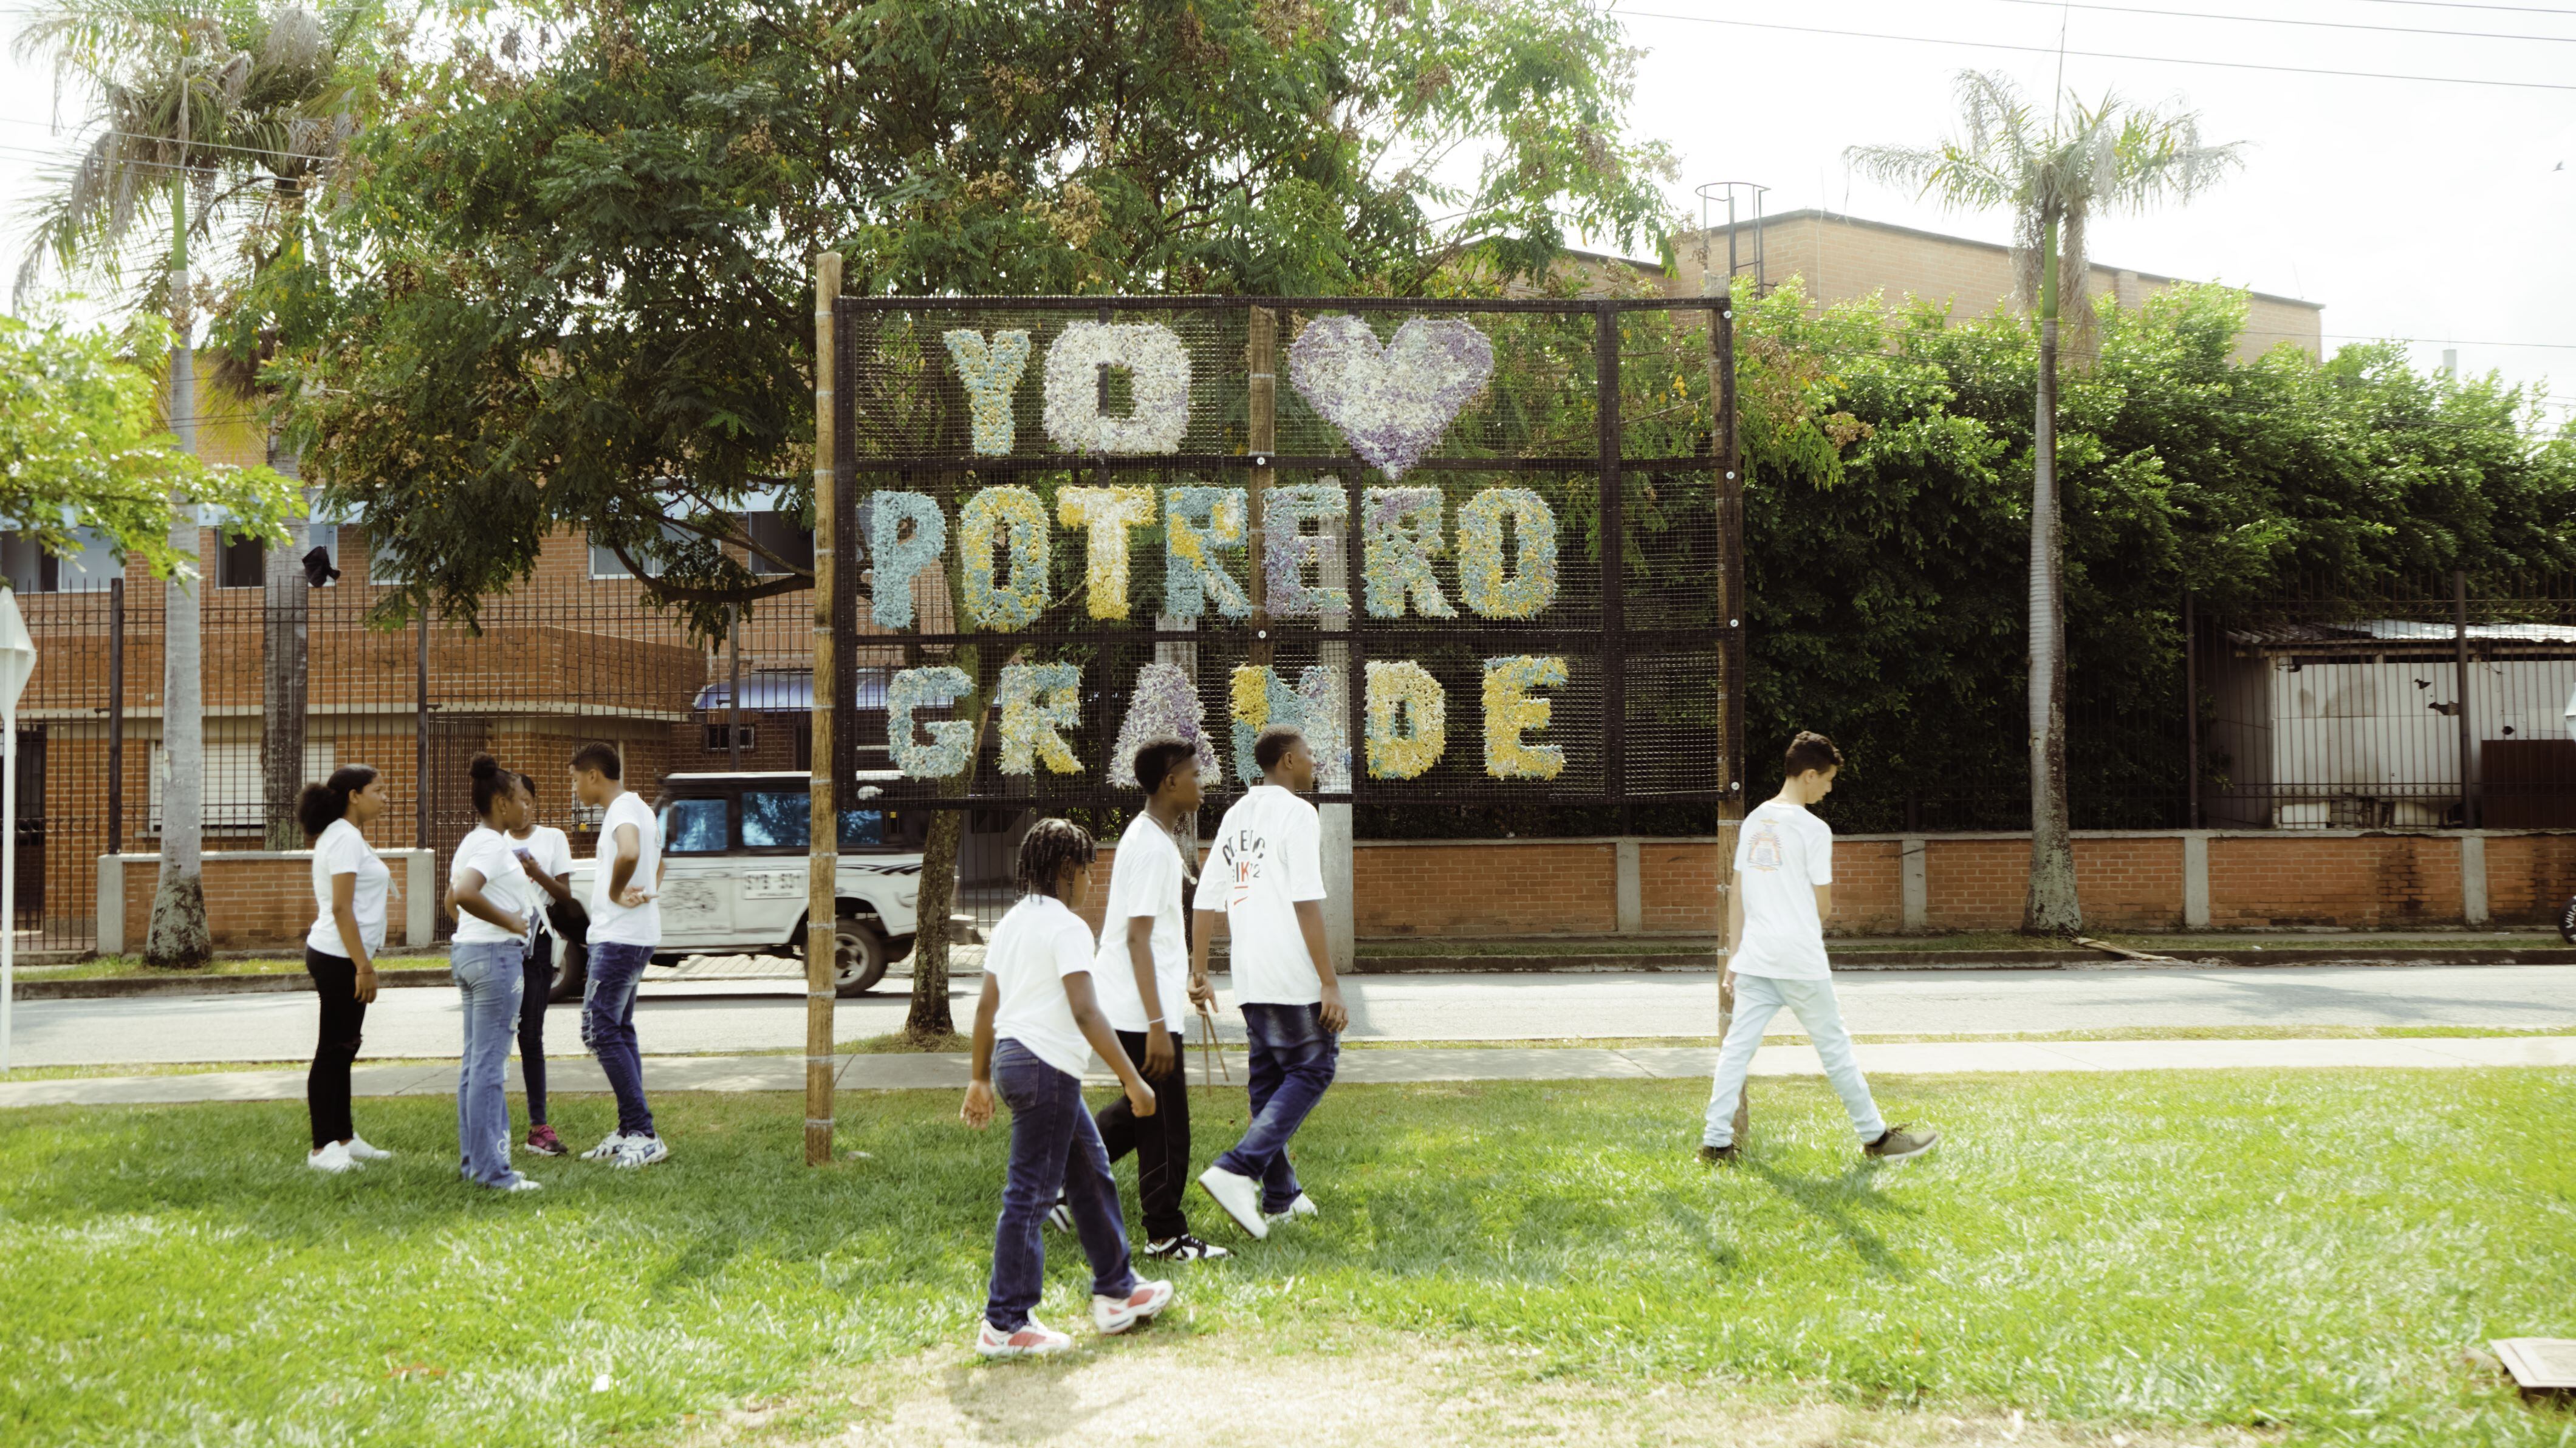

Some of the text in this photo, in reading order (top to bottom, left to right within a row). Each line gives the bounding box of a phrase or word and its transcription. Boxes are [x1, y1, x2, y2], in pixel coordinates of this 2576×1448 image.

[942, 319, 1191, 457] YO
[871, 483, 1559, 632] POTRERO
[886, 655, 1567, 788] GRANDE
